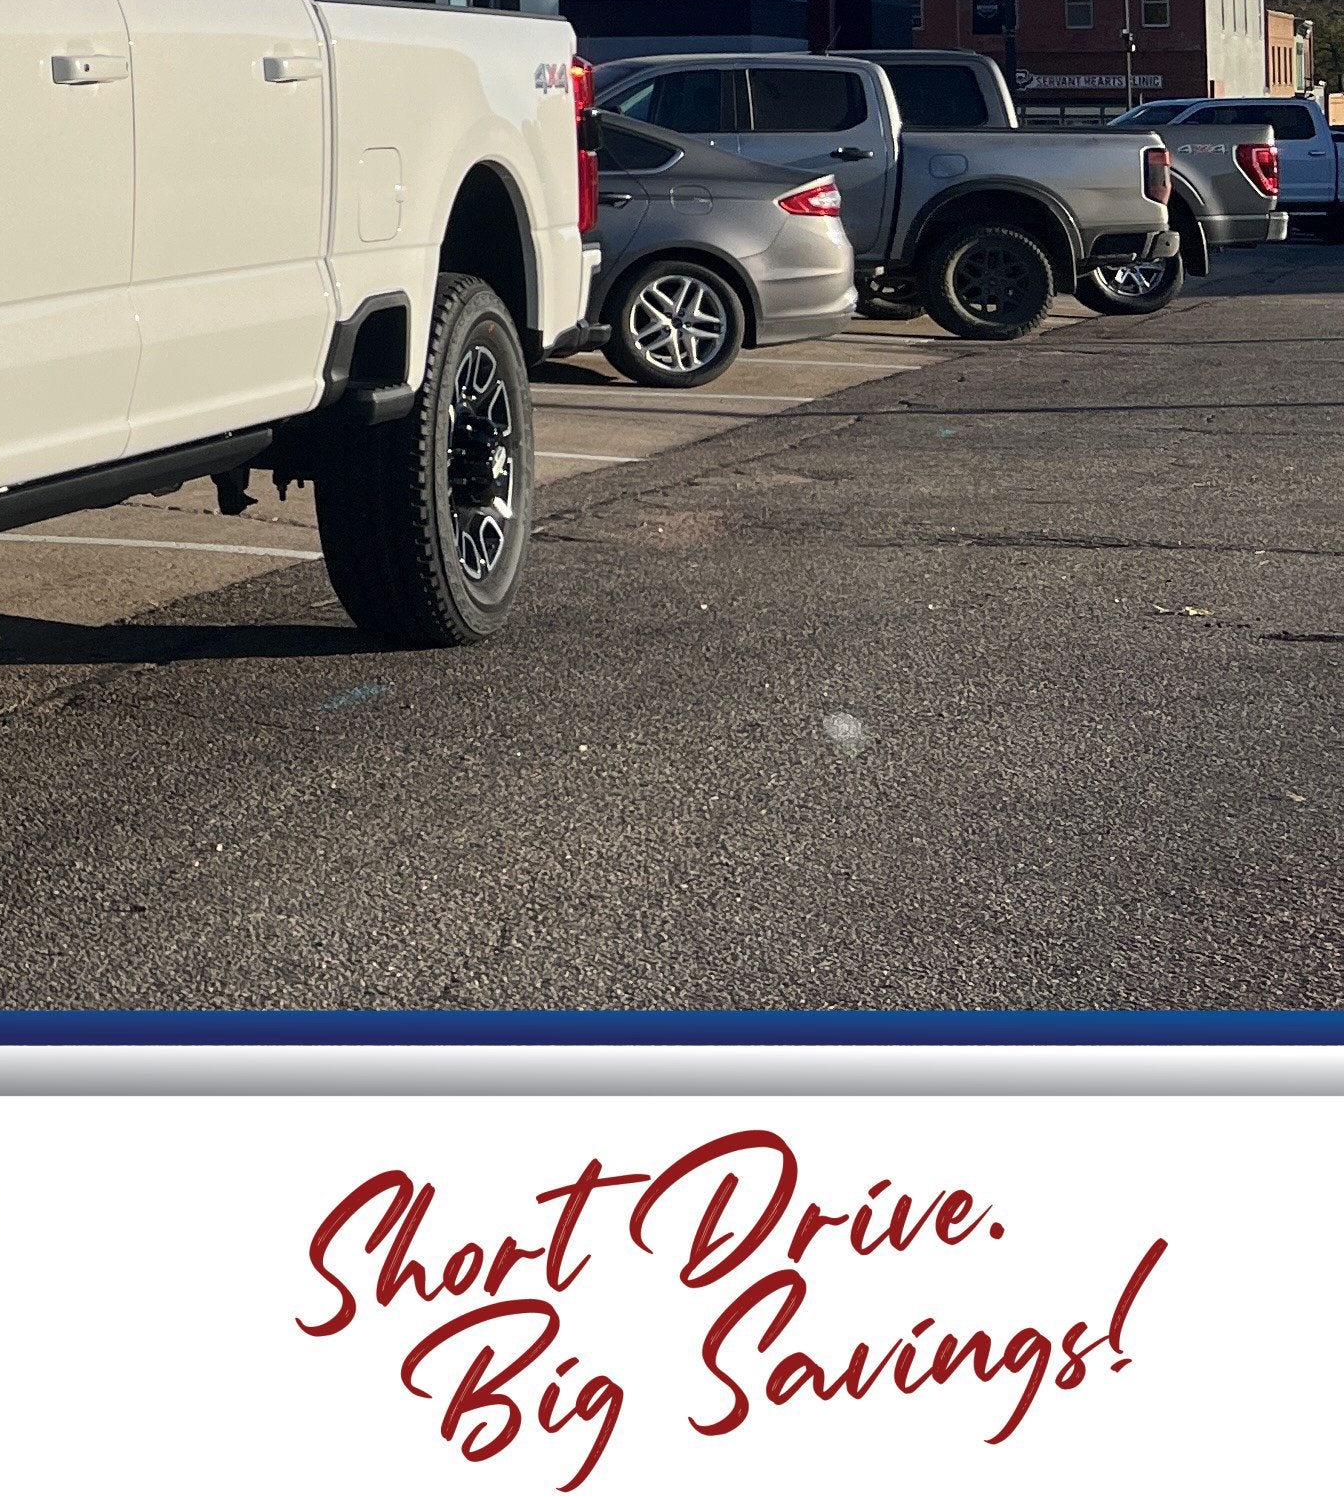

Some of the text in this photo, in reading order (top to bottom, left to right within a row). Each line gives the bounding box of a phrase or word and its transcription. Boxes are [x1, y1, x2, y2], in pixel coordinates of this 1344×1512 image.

[1035, 75, 1160, 88] SERVANT HEARTS LINIC
